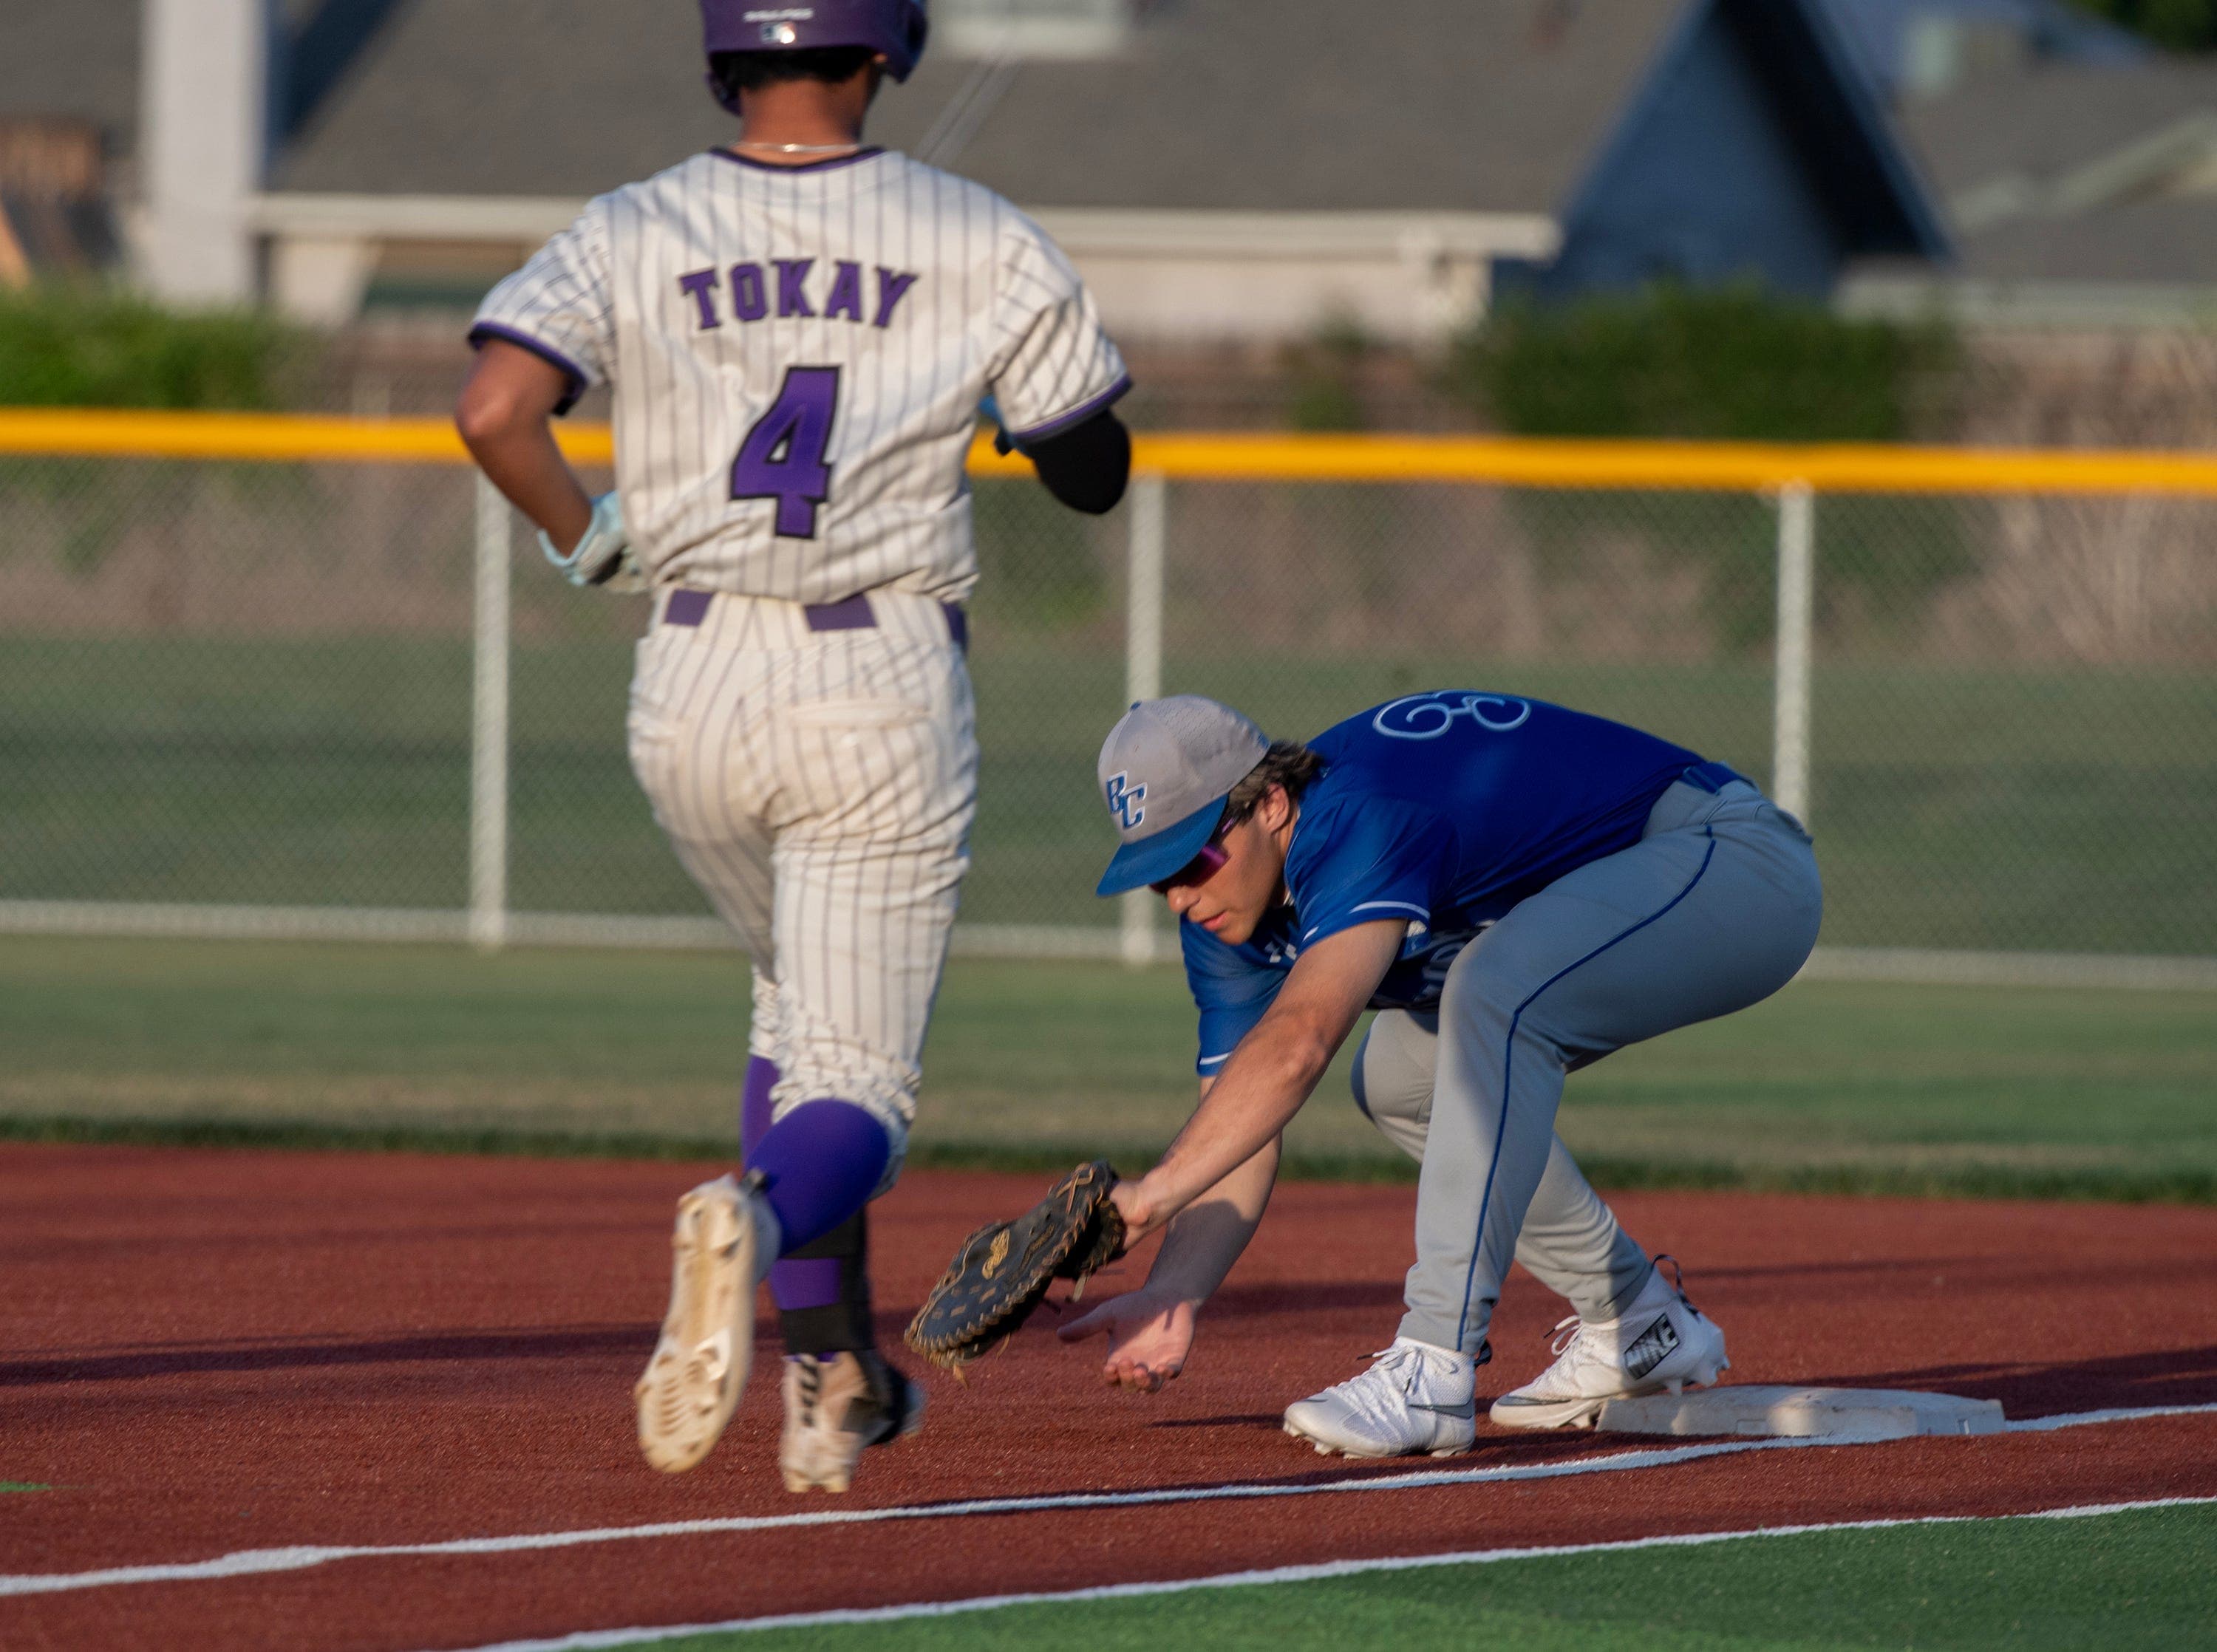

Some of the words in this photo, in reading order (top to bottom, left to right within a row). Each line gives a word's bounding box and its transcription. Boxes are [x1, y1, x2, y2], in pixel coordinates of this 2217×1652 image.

[679, 256, 919, 330] TOKAY
[729, 363, 843, 540] 4
[1106, 770, 1148, 830] BC
